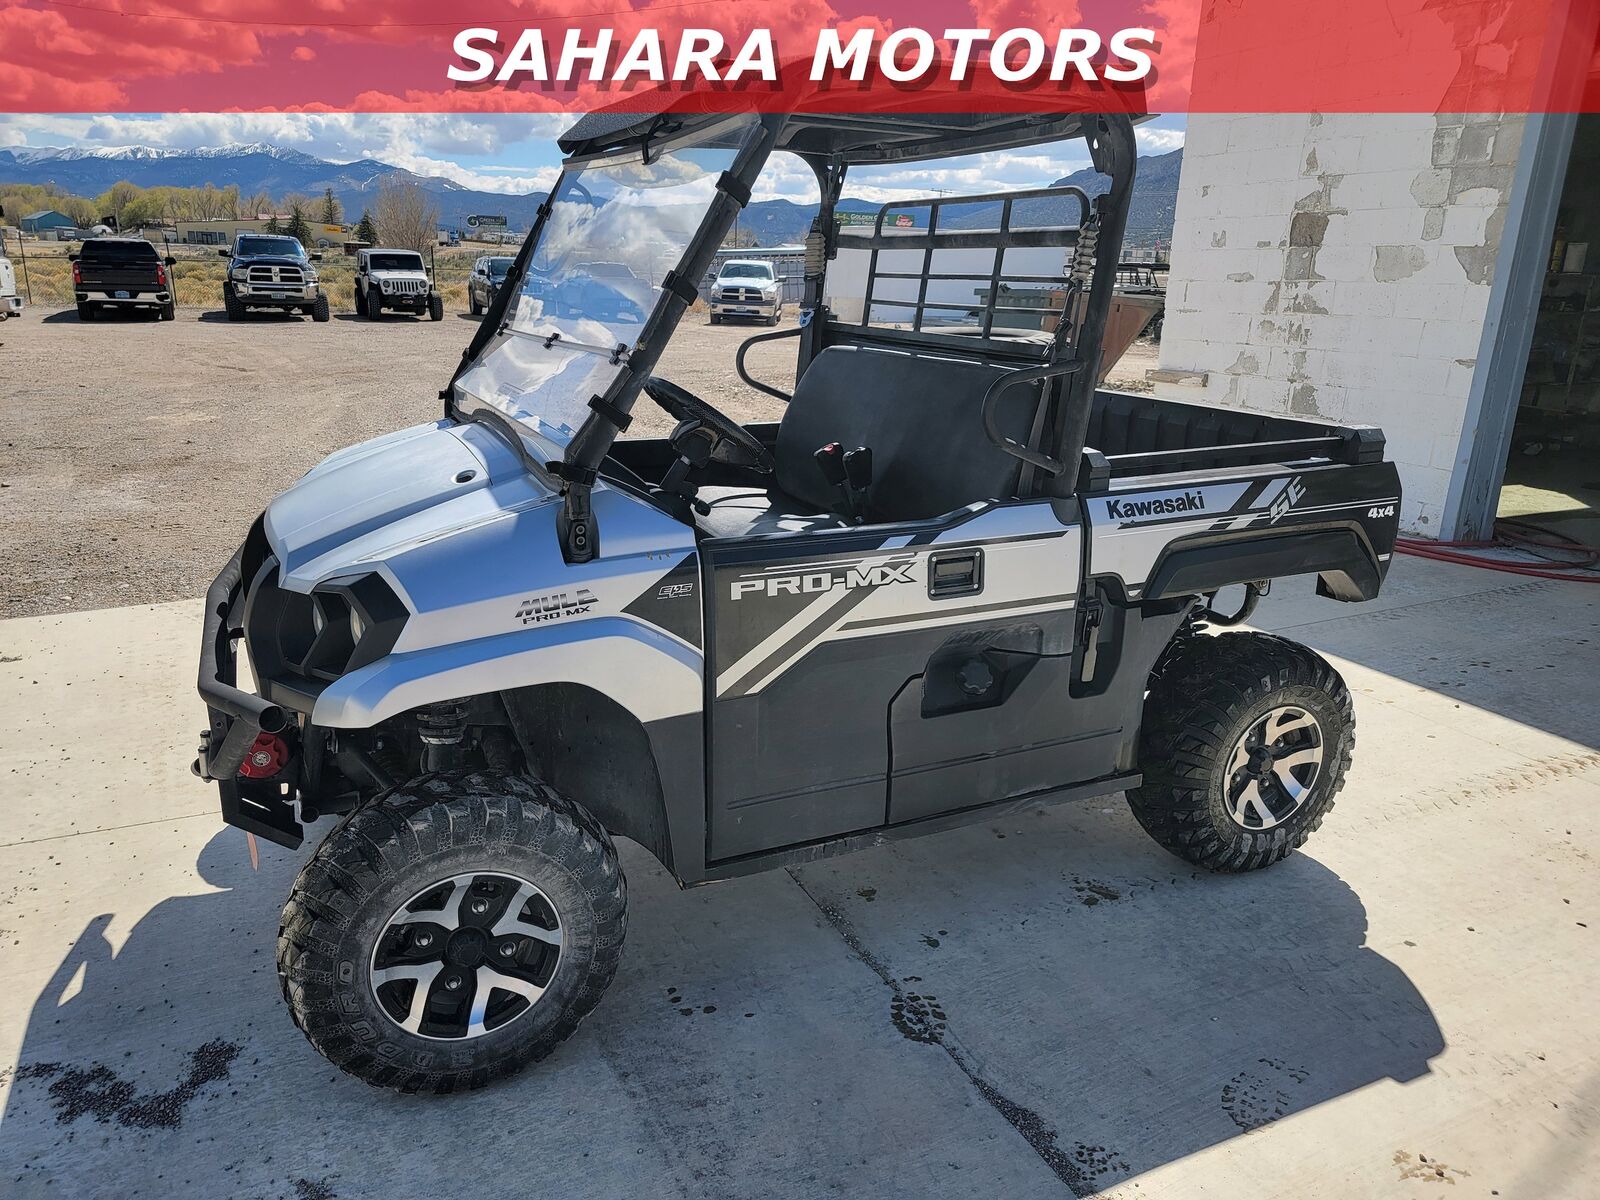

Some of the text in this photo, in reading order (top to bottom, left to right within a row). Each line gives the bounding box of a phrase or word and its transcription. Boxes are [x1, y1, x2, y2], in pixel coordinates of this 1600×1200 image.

[1106, 491, 1205, 519] Kawasaki
[1367, 506, 1395, 519] 4x4
[730, 563, 917, 601] PRO-MX
[515, 589, 599, 618] MULE
[522, 606, 591, 625] PRO-MX
